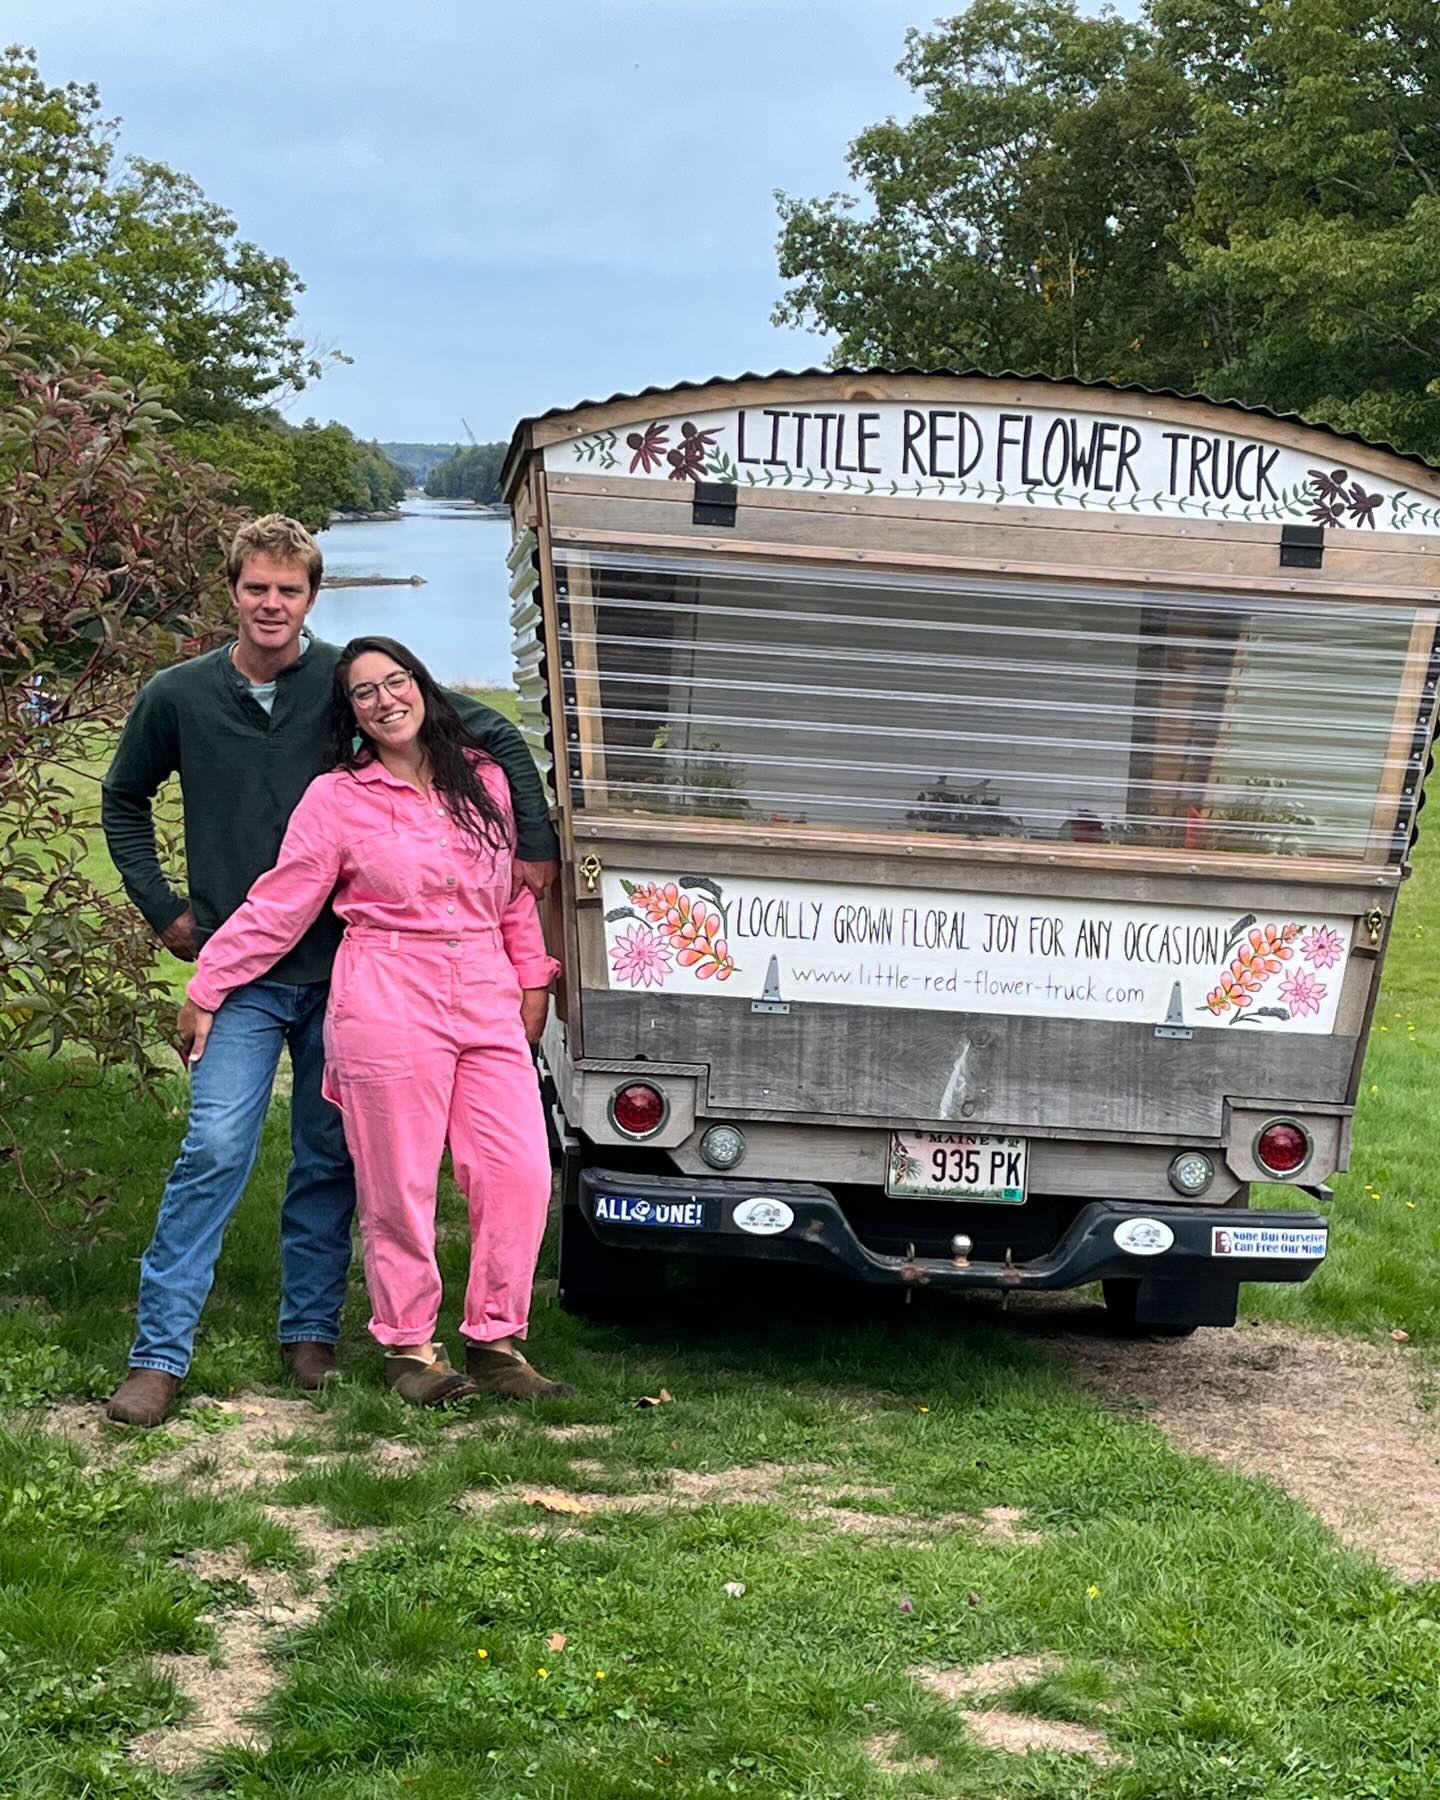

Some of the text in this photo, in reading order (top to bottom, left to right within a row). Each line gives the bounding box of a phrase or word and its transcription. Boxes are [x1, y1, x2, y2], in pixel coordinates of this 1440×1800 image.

[738, 409, 1280, 502] LITTLE RED FLOWER TRUCK
[736, 896, 1219, 966] LOCALLY GROWN FLORAL JOY FOR ANY OCCASION
[928, 1134, 990, 1146] MAINE
[931, 1148, 1022, 1187] 935 PK
[596, 1198, 632, 1220] ALL
[1233, 1231, 1259, 1241] None
[1234, 1241, 1254, 1252] Can
[1256, 1242, 1279, 1253] Free
[1281, 1243, 1300, 1254] Our
